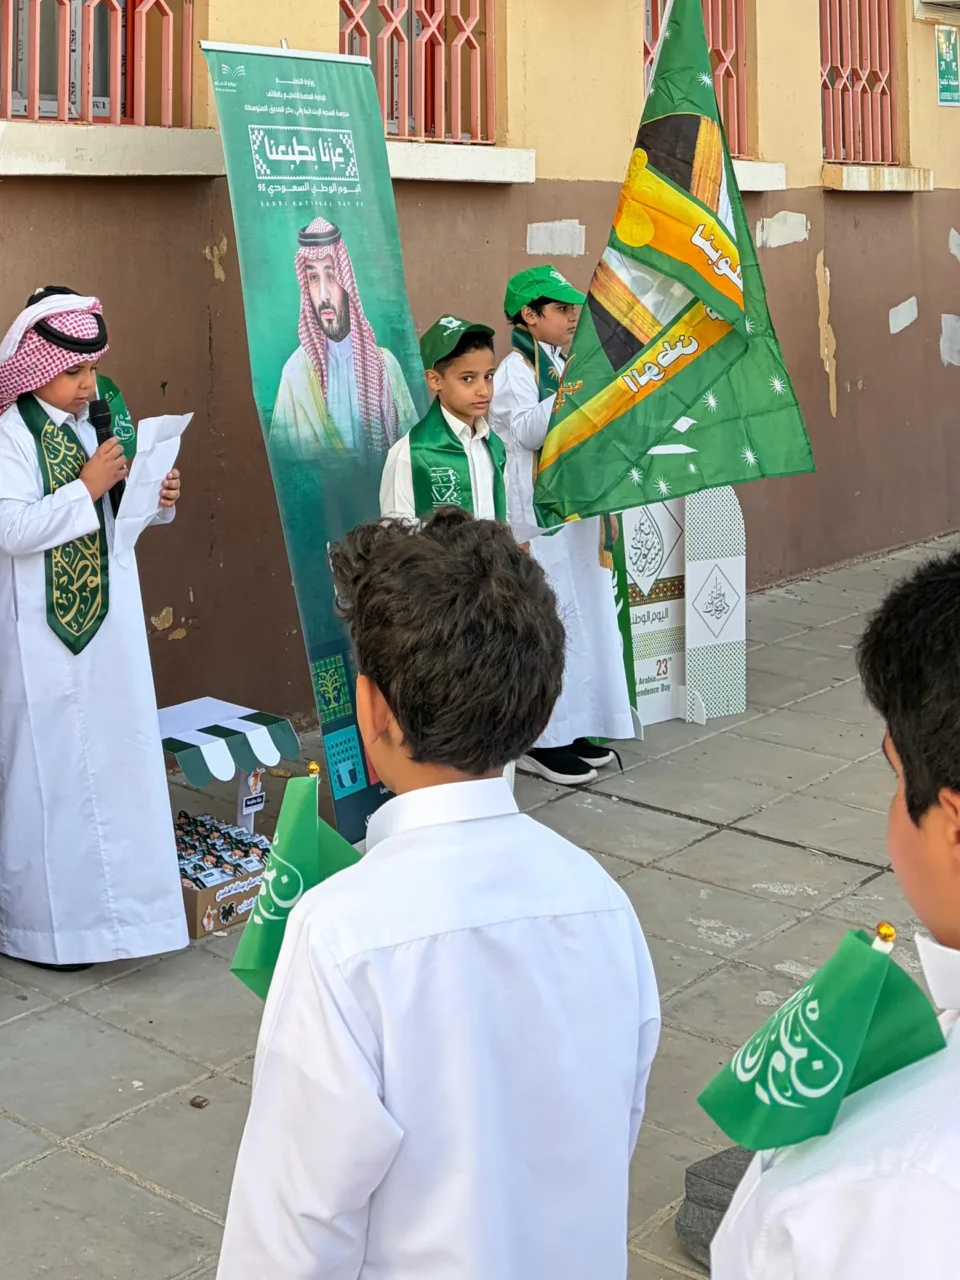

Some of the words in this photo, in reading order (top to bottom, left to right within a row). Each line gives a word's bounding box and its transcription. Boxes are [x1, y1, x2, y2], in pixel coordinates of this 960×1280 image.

[264, 136, 317, 170] بطبعنا
[318, 136, 345, 171] عزنا
[630, 611, 651, 625] الوطن
[651, 607, 669, 624] اليوم
[656, 658, 668, 677] 23
[638, 675, 656, 685] Arabia
[636, 686, 660, 697] endence
[660, 684, 671, 694] Day
